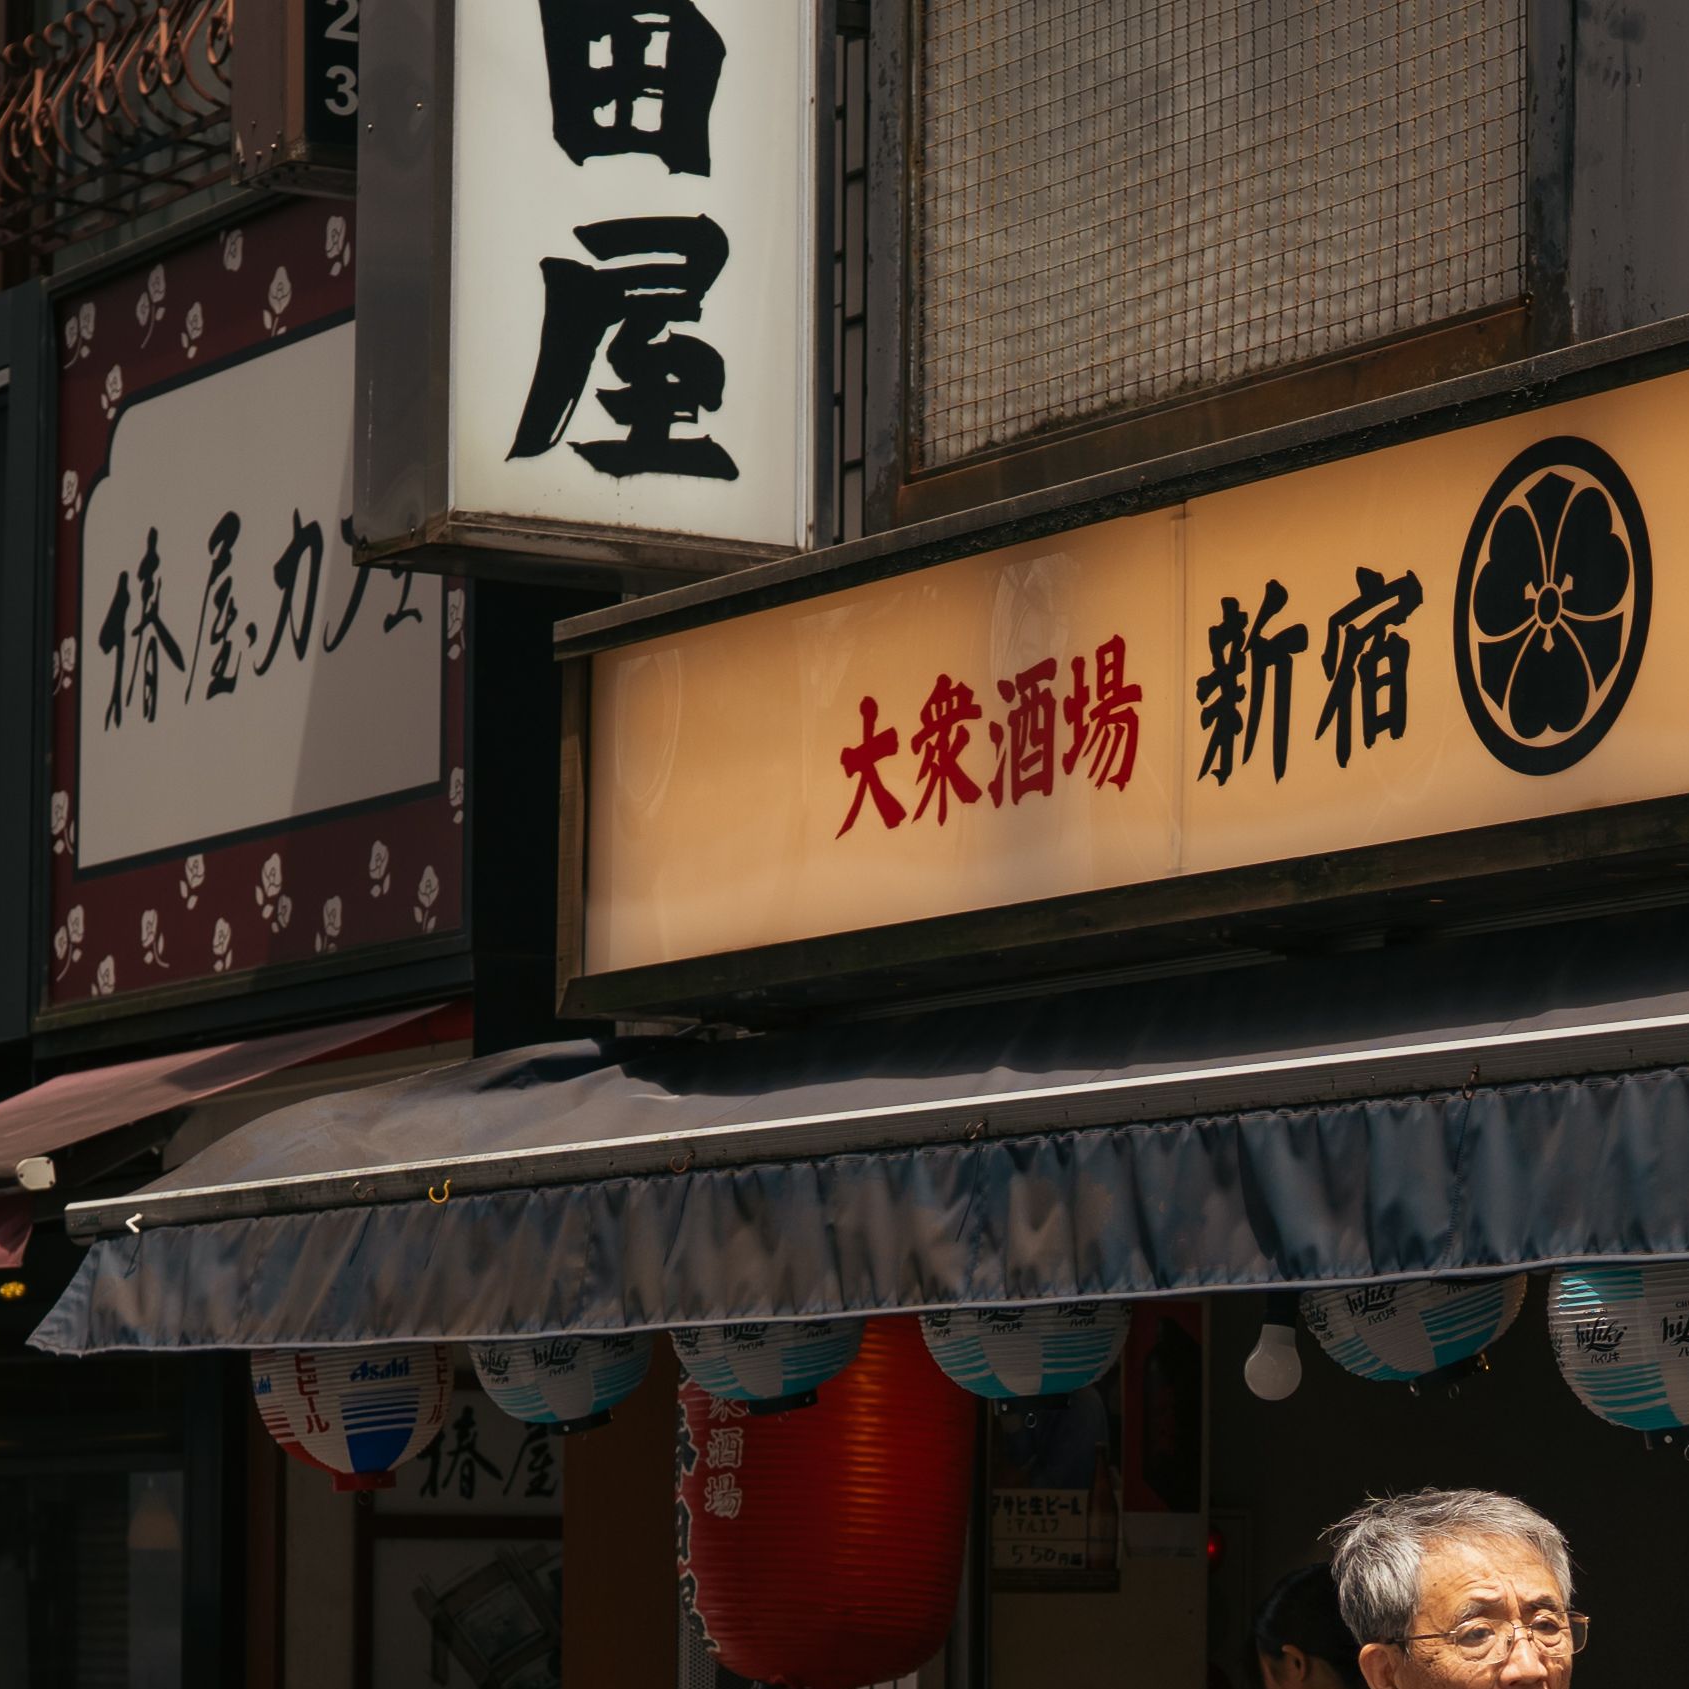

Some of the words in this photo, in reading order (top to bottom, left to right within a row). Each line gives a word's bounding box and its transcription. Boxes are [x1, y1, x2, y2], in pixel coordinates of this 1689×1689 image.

[325, 66, 358, 116] 3
[1196, 566, 1424, 785] 新宿
[836, 634, 1143, 839] 大衆酒場
[349, 1355, 410, 1382] Asahi
[418, 1403, 560, 1499] 椿屋
